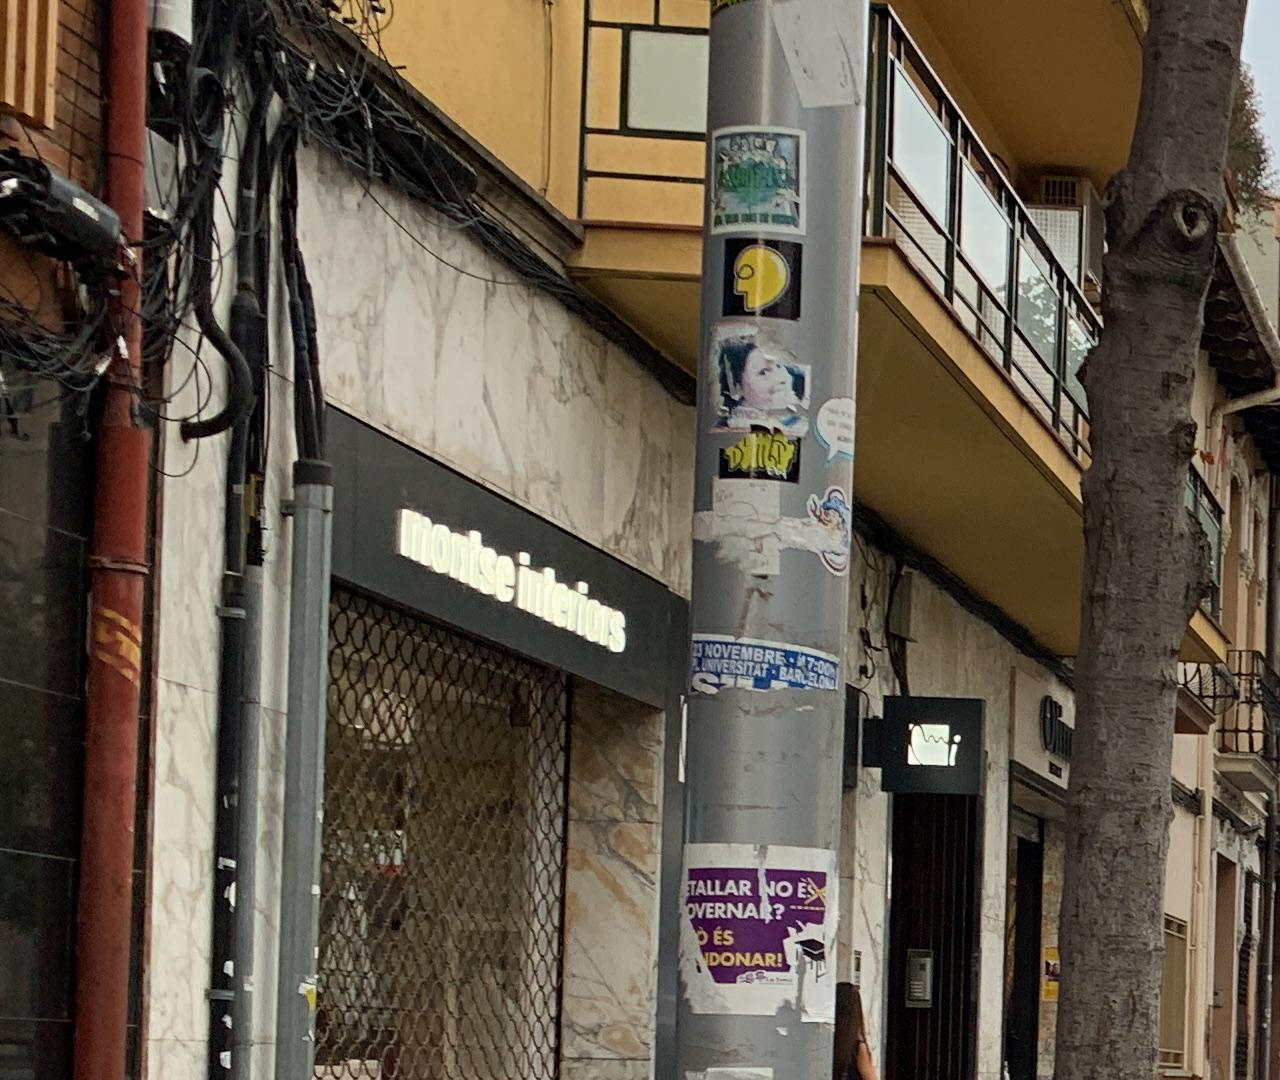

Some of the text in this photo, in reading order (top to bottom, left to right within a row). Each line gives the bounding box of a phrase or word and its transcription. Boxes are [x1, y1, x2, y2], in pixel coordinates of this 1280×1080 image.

[398, 508, 627, 654] montse interiors
[703, 643, 786, 666] NOVEMBRE
[701, 657, 769, 679] UNIVERSITAT
[779, 666, 835, 690] BARCELONA
[759, 880, 793, 899] NO
